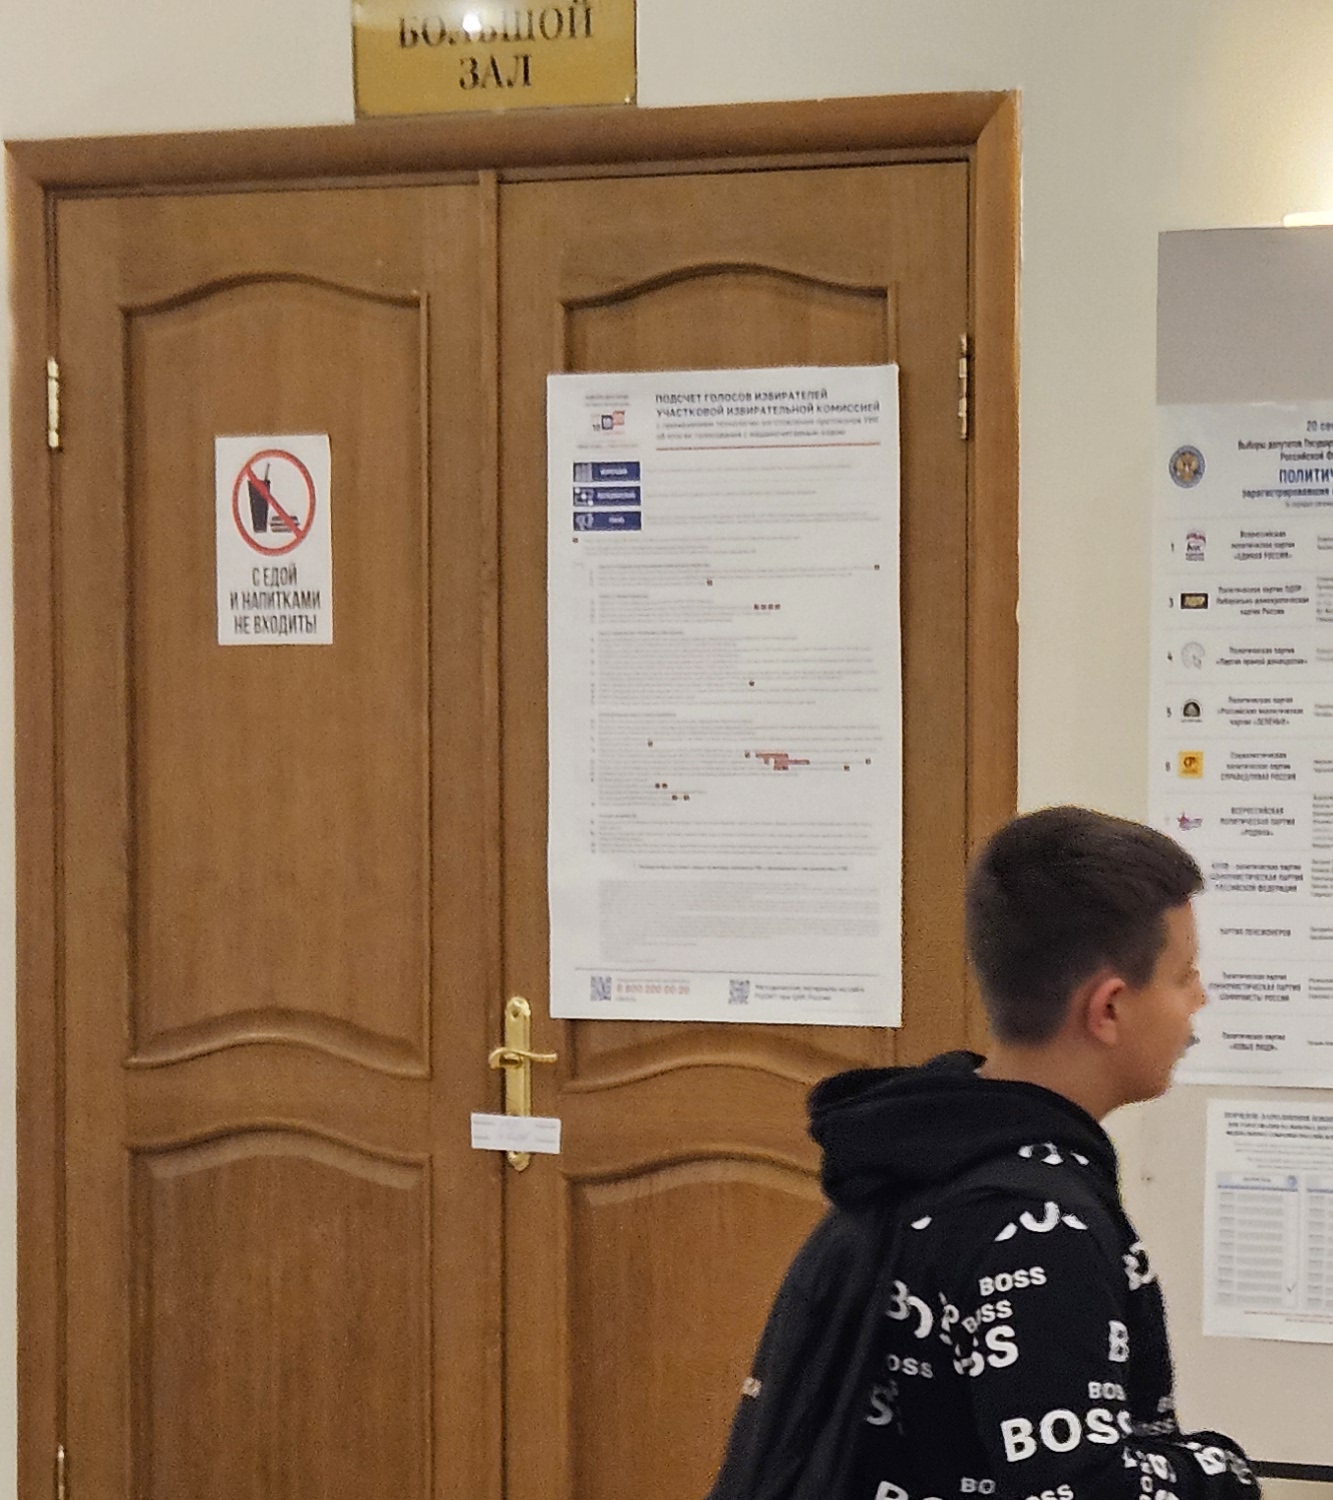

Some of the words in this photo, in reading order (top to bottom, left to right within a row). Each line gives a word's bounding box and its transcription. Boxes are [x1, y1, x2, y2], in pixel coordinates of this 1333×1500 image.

[459, 53, 532, 90] ЗАЛ
[656, 394, 701, 404] ПОДСЧЕТ
[704, 392, 751, 402] ГОЛОСОВ
[754, 388, 828, 401] ИЗБИРАТЕЛЕЙ
[656, 405, 724, 418] УЧАСТКОВОЙ
[727, 403, 814, 416] ИЗБИРАТЕЛЬНОЙ
[816, 400, 881, 413] КОМИССИЕЙ
[252, 567, 260, 587] С
[263, 563, 298, 588] ЕДОЙ
[230, 591, 239, 611] И
[242, 590, 321, 610] НАПИТКАМИ
[234, 615, 250, 634] НЕ
[978, 1266, 1048, 1297] BOSS
[961, 1299, 1013, 1334] BSS
